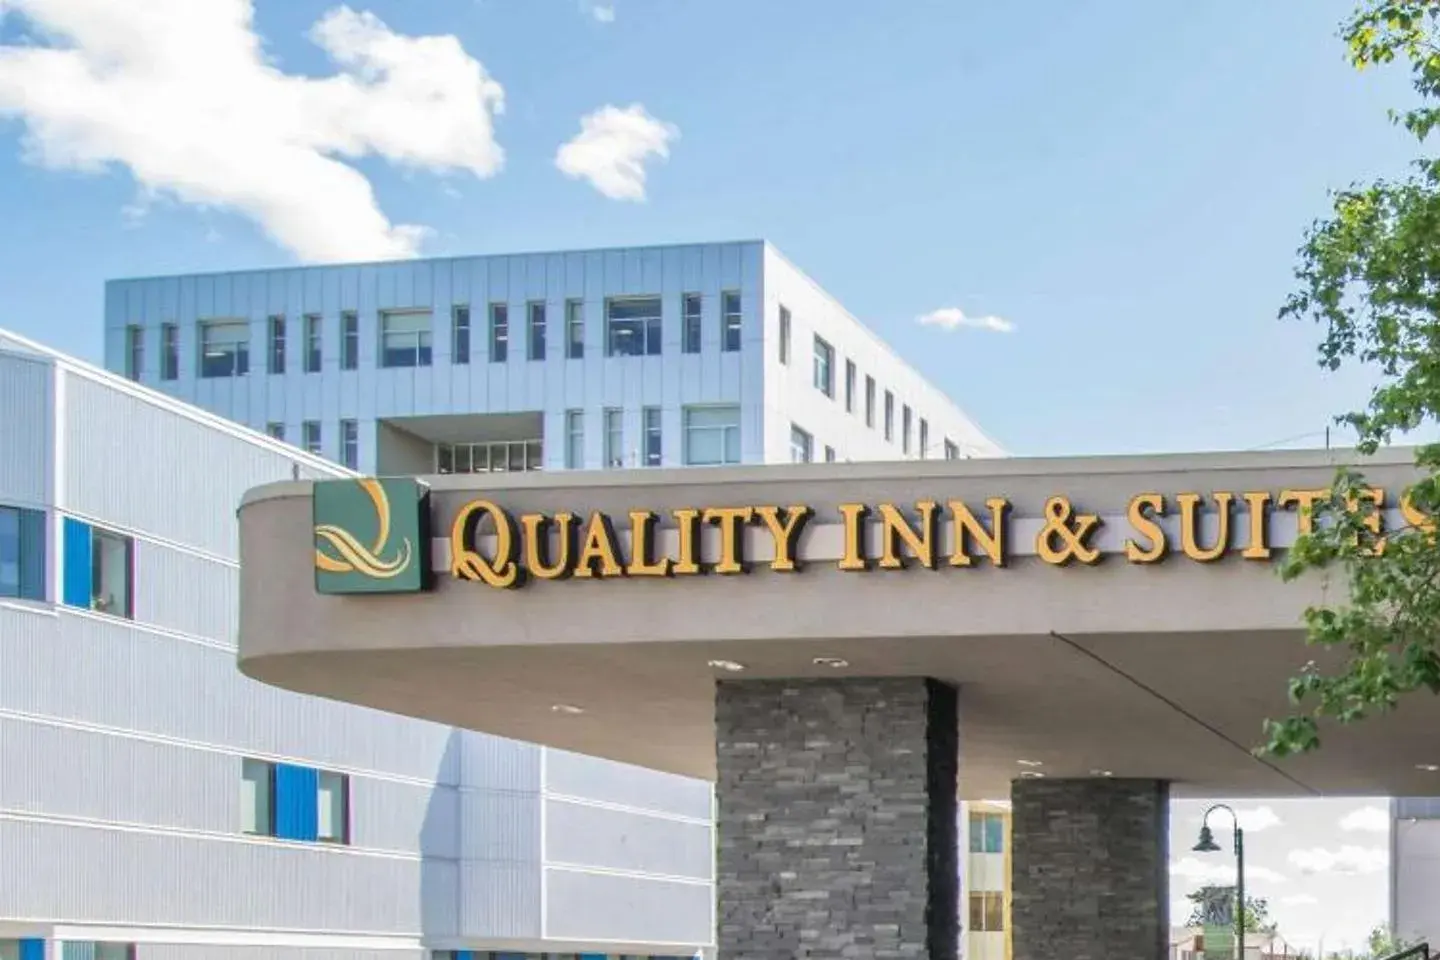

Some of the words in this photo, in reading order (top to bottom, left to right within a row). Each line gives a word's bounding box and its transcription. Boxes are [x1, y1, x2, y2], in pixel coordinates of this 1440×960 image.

[451, 499, 809, 588] QUALITY
[838, 497, 1009, 569] INN
[1036, 494, 1100, 566] &
